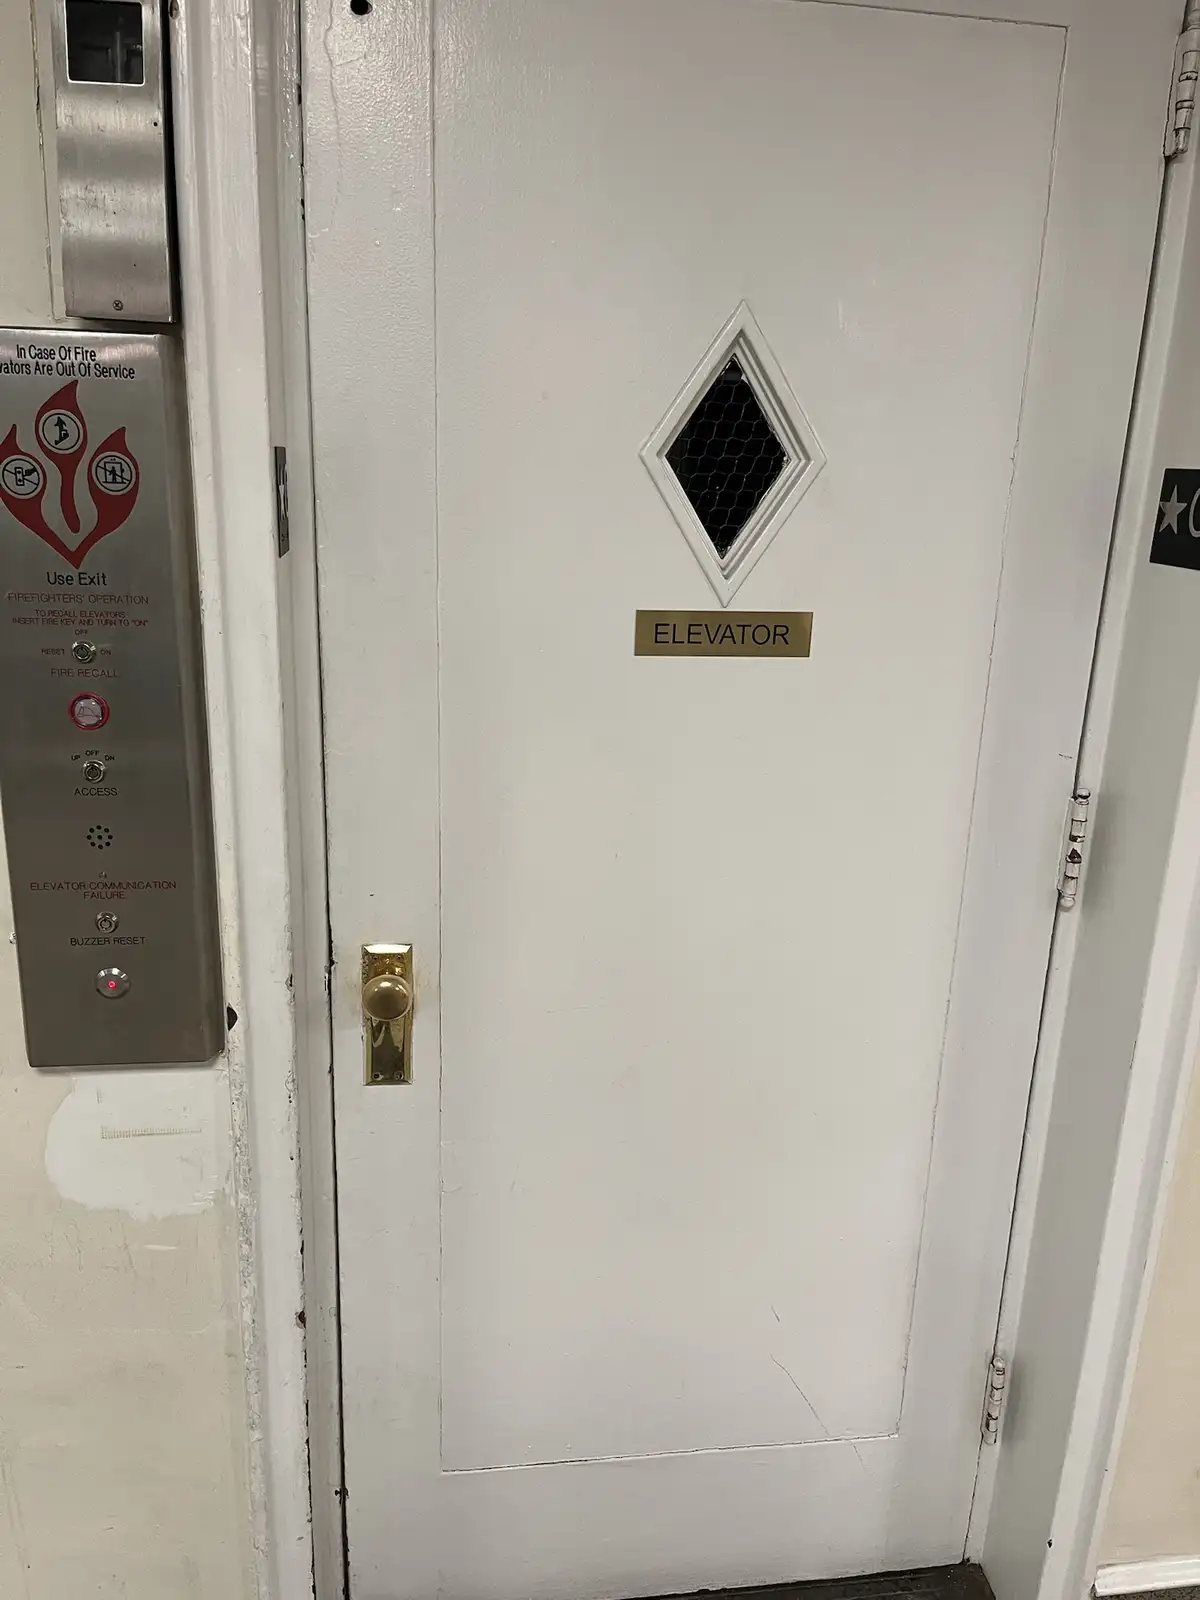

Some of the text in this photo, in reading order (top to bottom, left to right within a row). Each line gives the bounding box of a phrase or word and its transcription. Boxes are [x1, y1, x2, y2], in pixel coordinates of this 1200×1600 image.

[16, 344, 97, 362] In Case Of Fire
[34, 361, 54, 376] Are
[56, 361, 75, 377] Out
[78, 362, 91, 378] Of
[94, 362, 135, 380] Service
[46, 571, 107, 587] Use Exit
[88, 594, 149, 605] OPERATION
[35, 609, 126, 619] TO RECALL ELEVATORS
[12, 617, 40, 626] INSERT
[41, 617, 60, 626] FIRE
[60, 618, 77, 627] KEY
[79, 618, 94, 627] AND
[97, 618, 117, 627] TURN
[118, 619, 130, 628] TO
[653, 622, 790, 646] ELEVATOR
[50, 668, 120, 678] FIRE RECALL
[74, 787, 118, 797] ACCESS
[29, 880, 177, 891] ELEVATOR COMMUNICATION
[83, 891, 126, 900] FAILURE
[70, 936, 146, 947] BUZZER RESET
